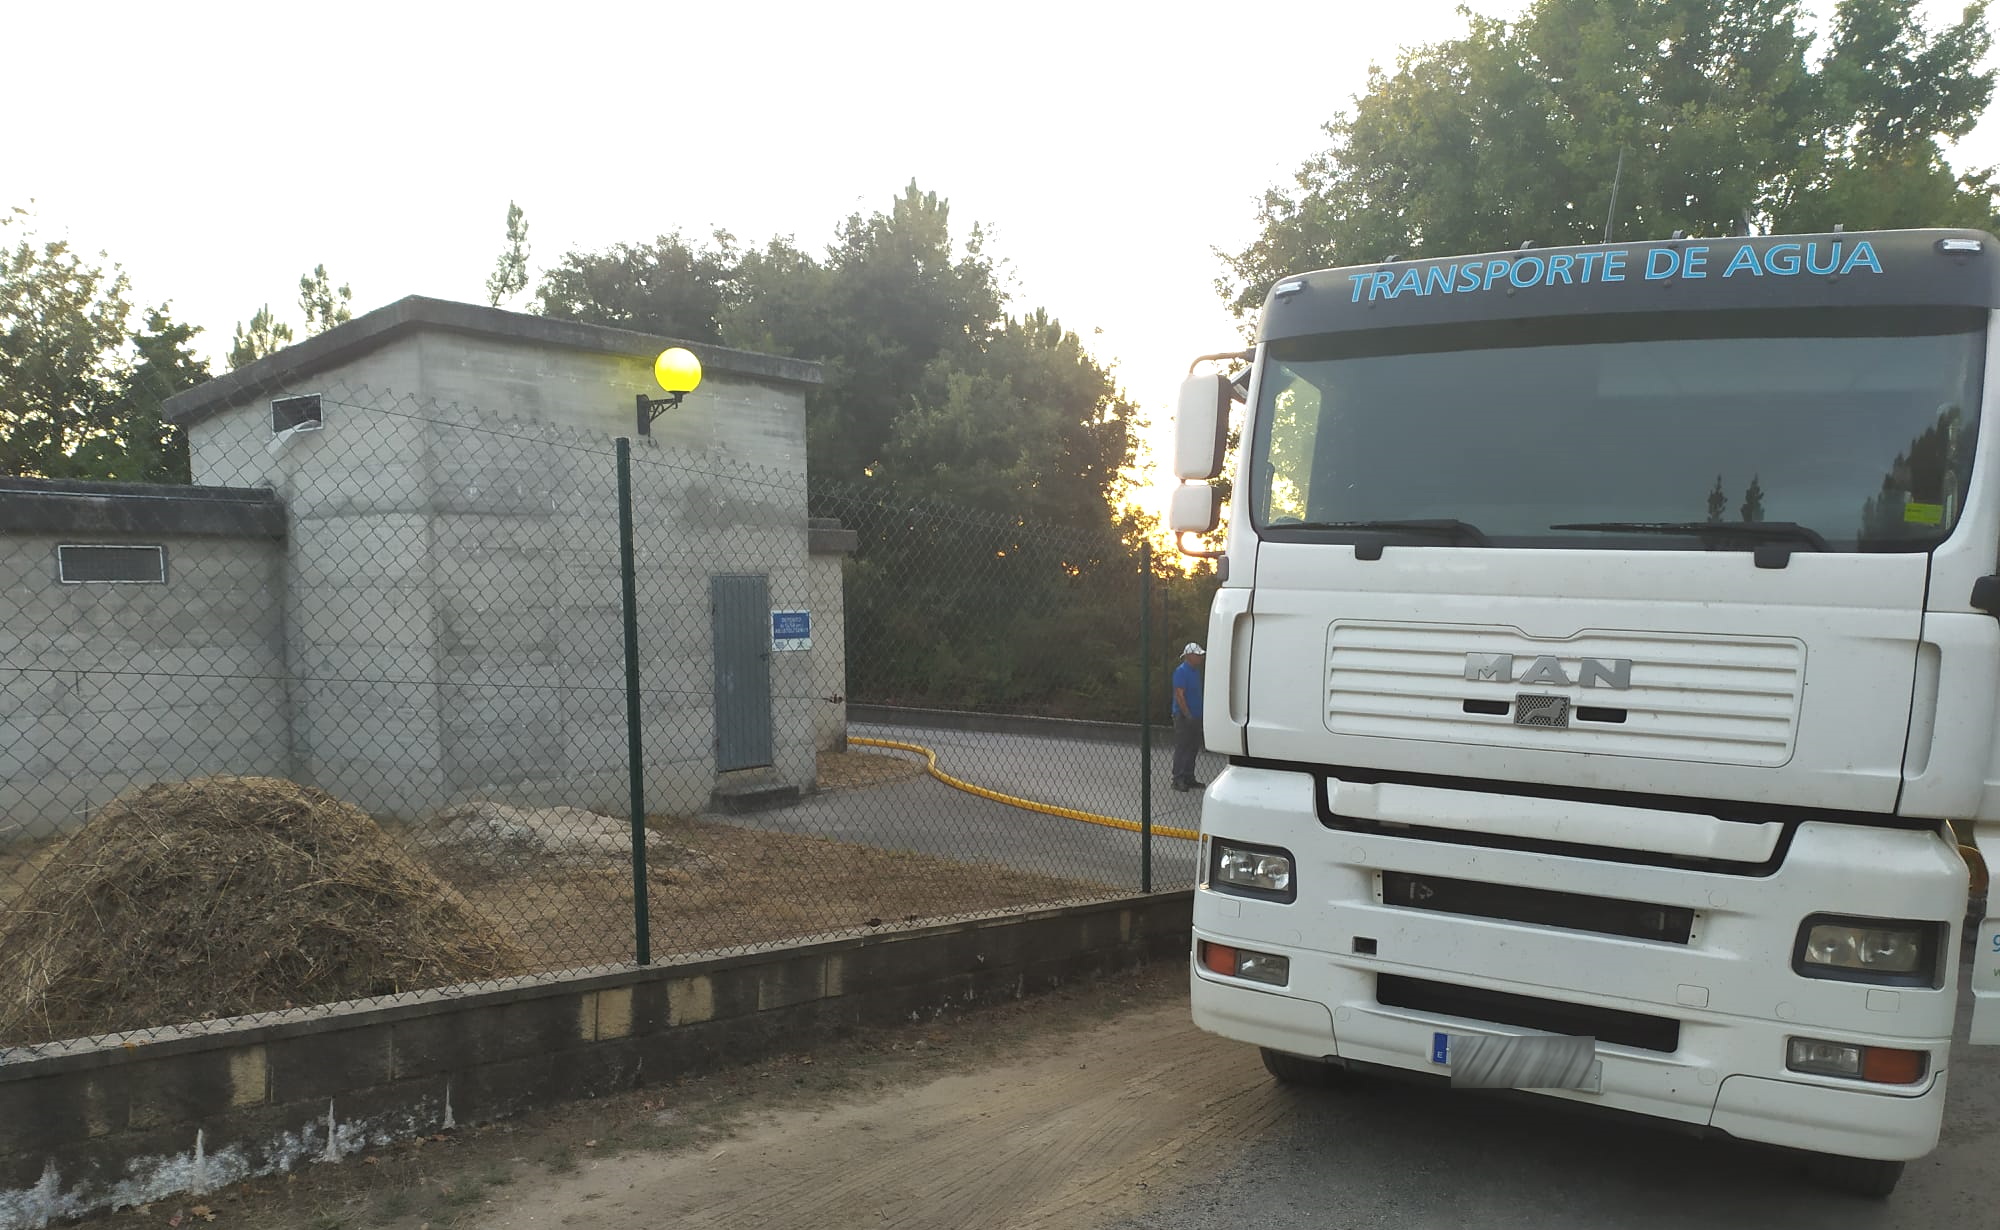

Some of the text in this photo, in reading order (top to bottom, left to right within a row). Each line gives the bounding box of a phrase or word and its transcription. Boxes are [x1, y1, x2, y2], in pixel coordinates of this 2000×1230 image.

[1348, 241, 1884, 303] TRANSPORTE DE AGUA
[1464, 652, 1632, 690] MAN
[1437, 1051, 1444, 1059] E
